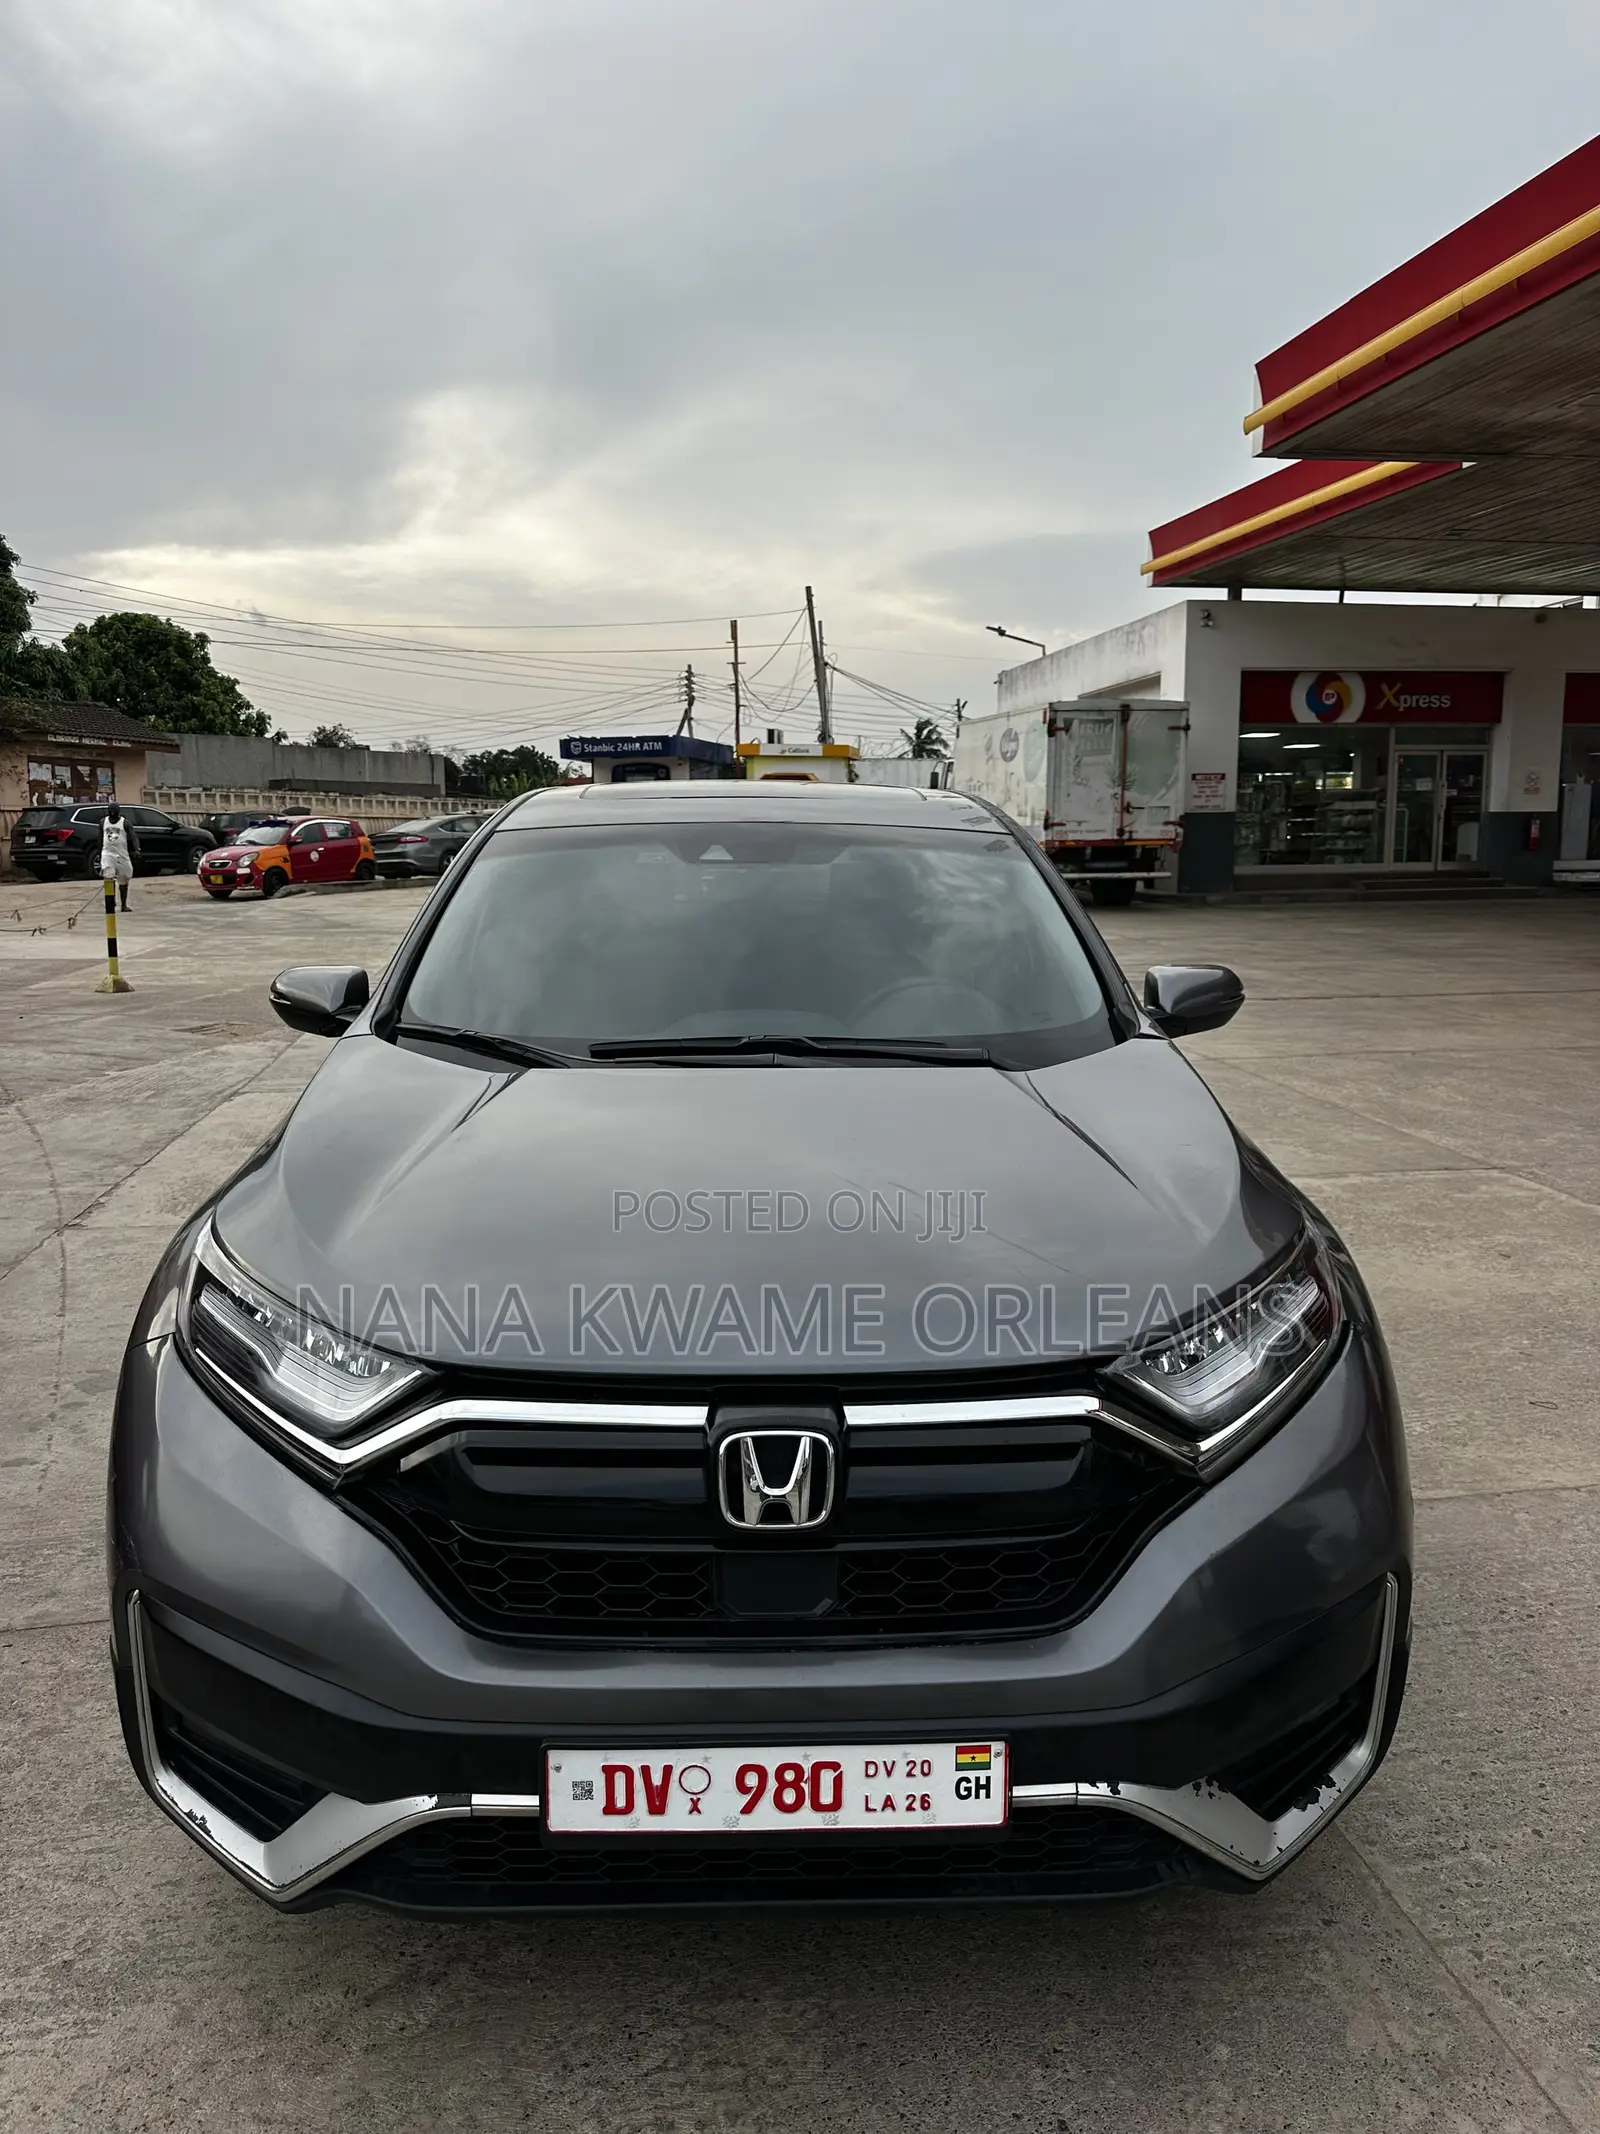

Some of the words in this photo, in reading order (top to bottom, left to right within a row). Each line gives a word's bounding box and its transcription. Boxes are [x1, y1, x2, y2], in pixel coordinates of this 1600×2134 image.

[1375, 682, 1451, 711] Xpress
[583, 743, 615, 752] Stanbic
[617, 742, 641, 752] 24HR
[643, 741, 663, 751] ATM
[864, 1760, 896, 1778] DV
[905, 1759, 932, 1777] 20
[601, 1764, 674, 1815] DV
[735, 1760, 843, 1815] 980
[954, 1775, 992, 1800] GH
[864, 1794, 896, 1812] LA
[905, 1793, 932, 1811] 26
